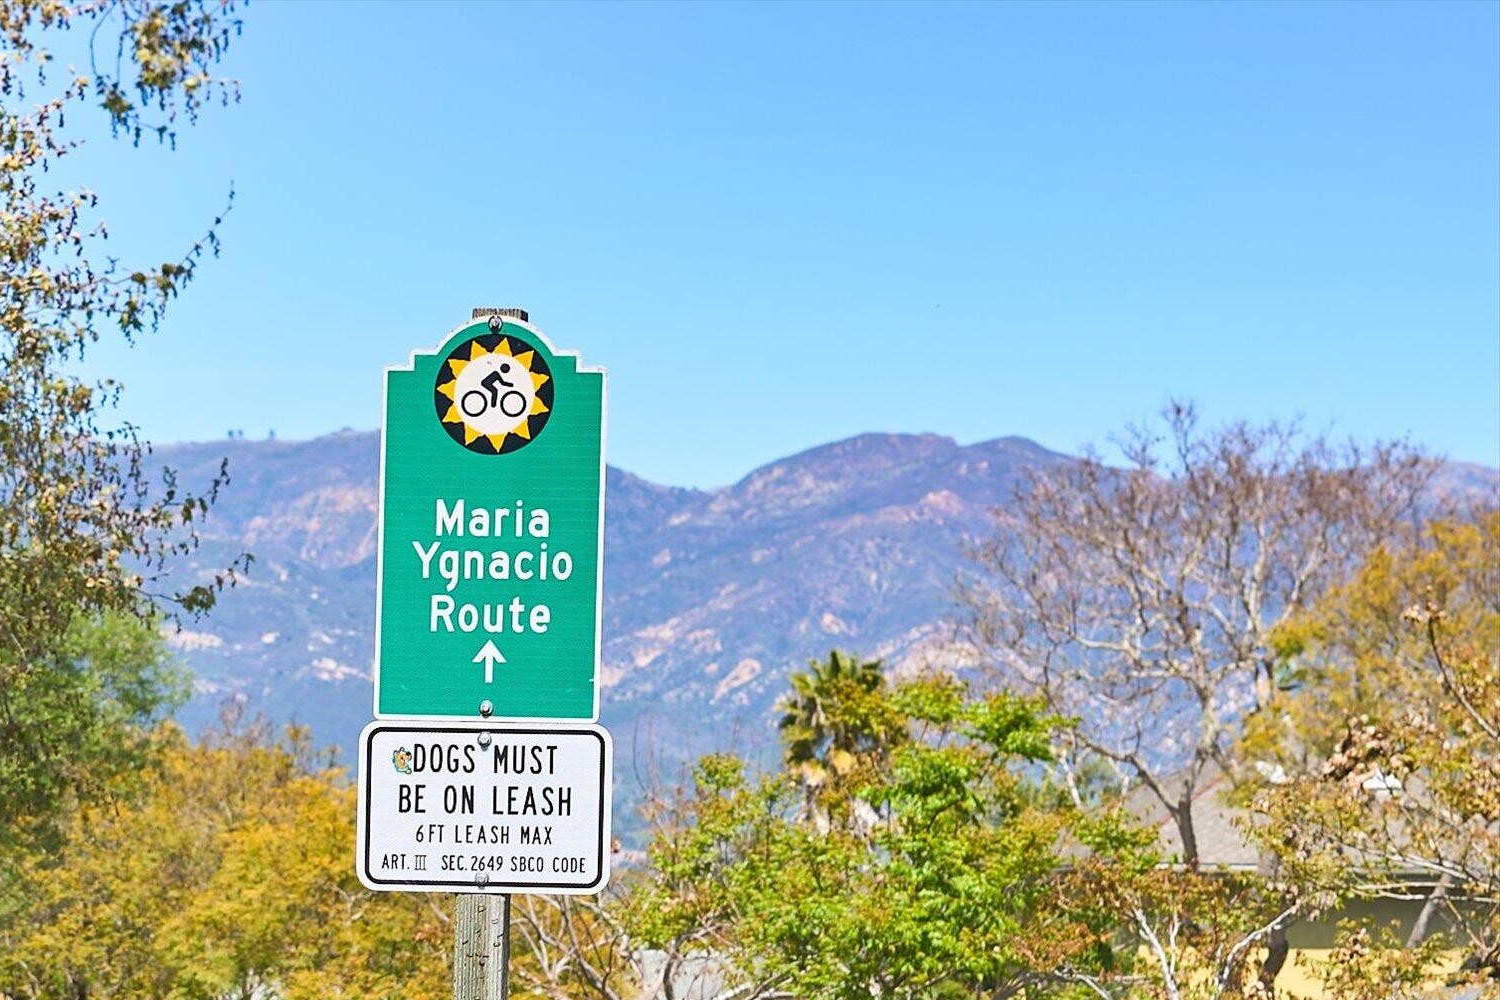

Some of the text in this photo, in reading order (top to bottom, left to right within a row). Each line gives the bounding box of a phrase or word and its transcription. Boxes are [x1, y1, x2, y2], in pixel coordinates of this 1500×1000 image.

[435, 498, 550, 538] Maria
[412, 541, 573, 592] Ygnacio
[430, 594, 551, 634] Route
[413, 743, 558, 775] DOGS MUST
[398, 784, 572, 817] BE ON LEASH
[454, 824, 510, 845] LEASH
[520, 825, 553, 845] MAX
[381, 853, 410, 870] ART.
[510, 855, 544, 873] SBCO
[552, 856, 586, 874] CODE
